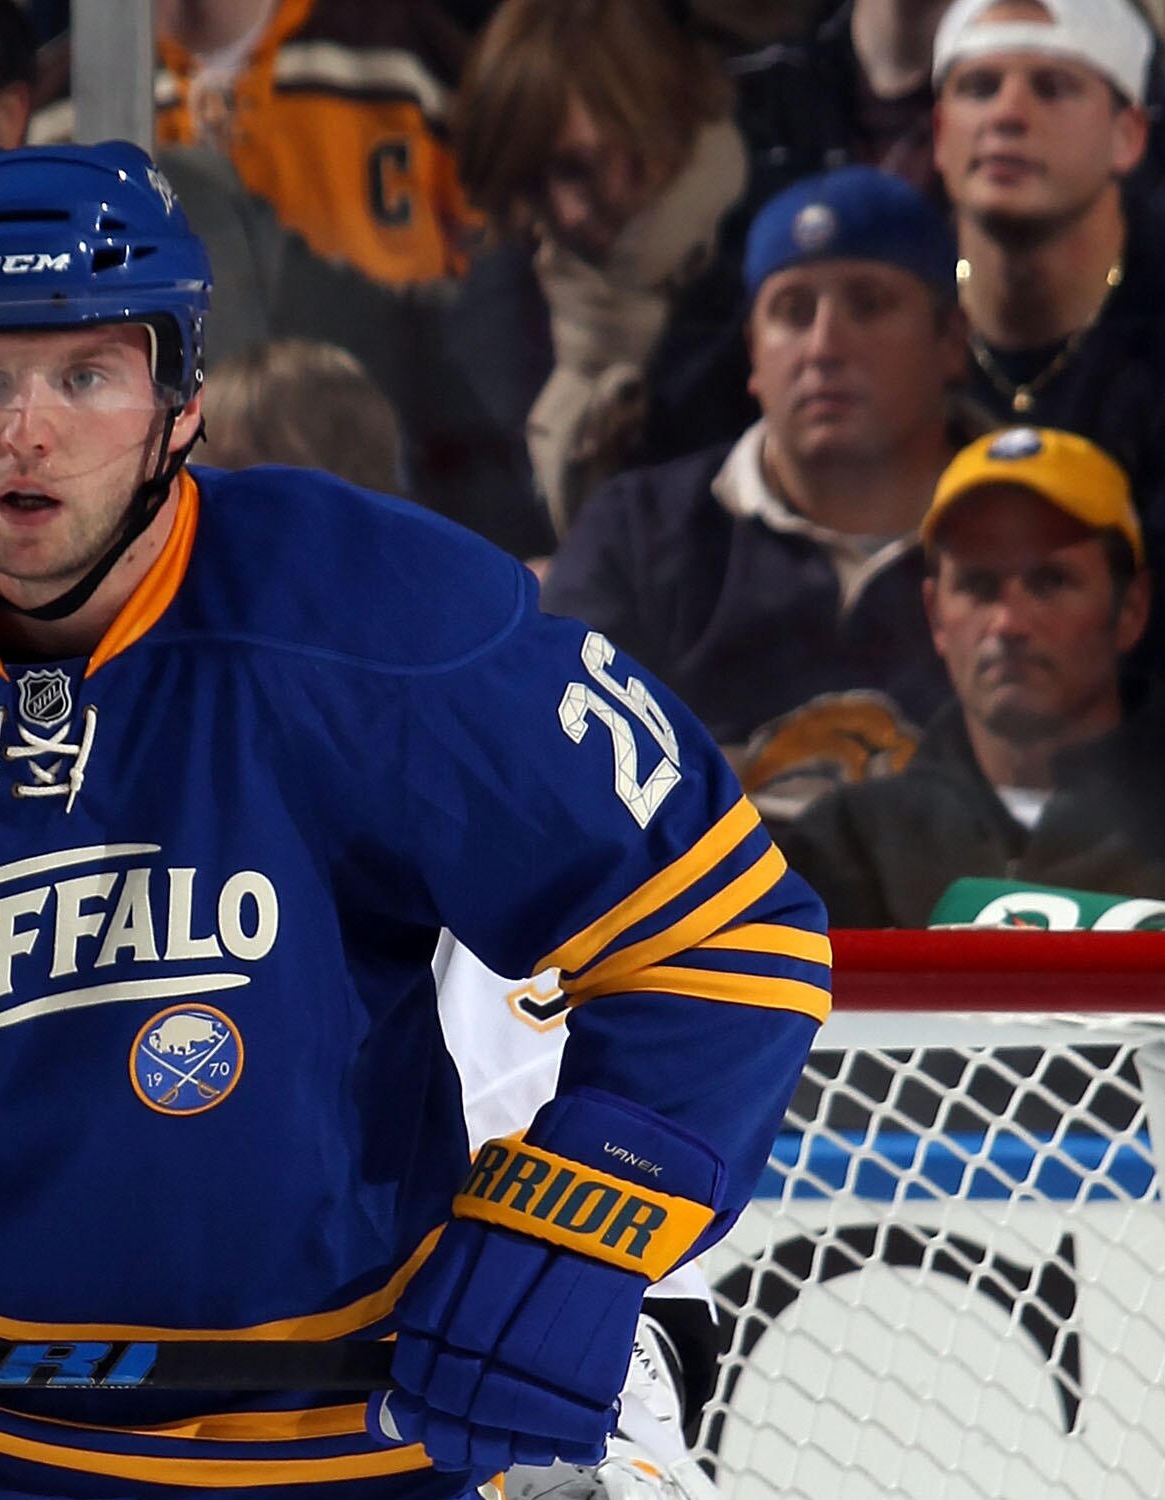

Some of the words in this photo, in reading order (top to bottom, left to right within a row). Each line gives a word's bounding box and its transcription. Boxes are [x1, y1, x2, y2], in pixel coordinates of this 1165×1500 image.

[367, 142, 411, 227] C
[32, 684, 62, 714] NHL
[558, 631, 682, 829] 26
[146, 1072, 164, 1088] 19
[208, 1061, 231, 1078] 70
[603, 1141, 664, 1177] VANEK
